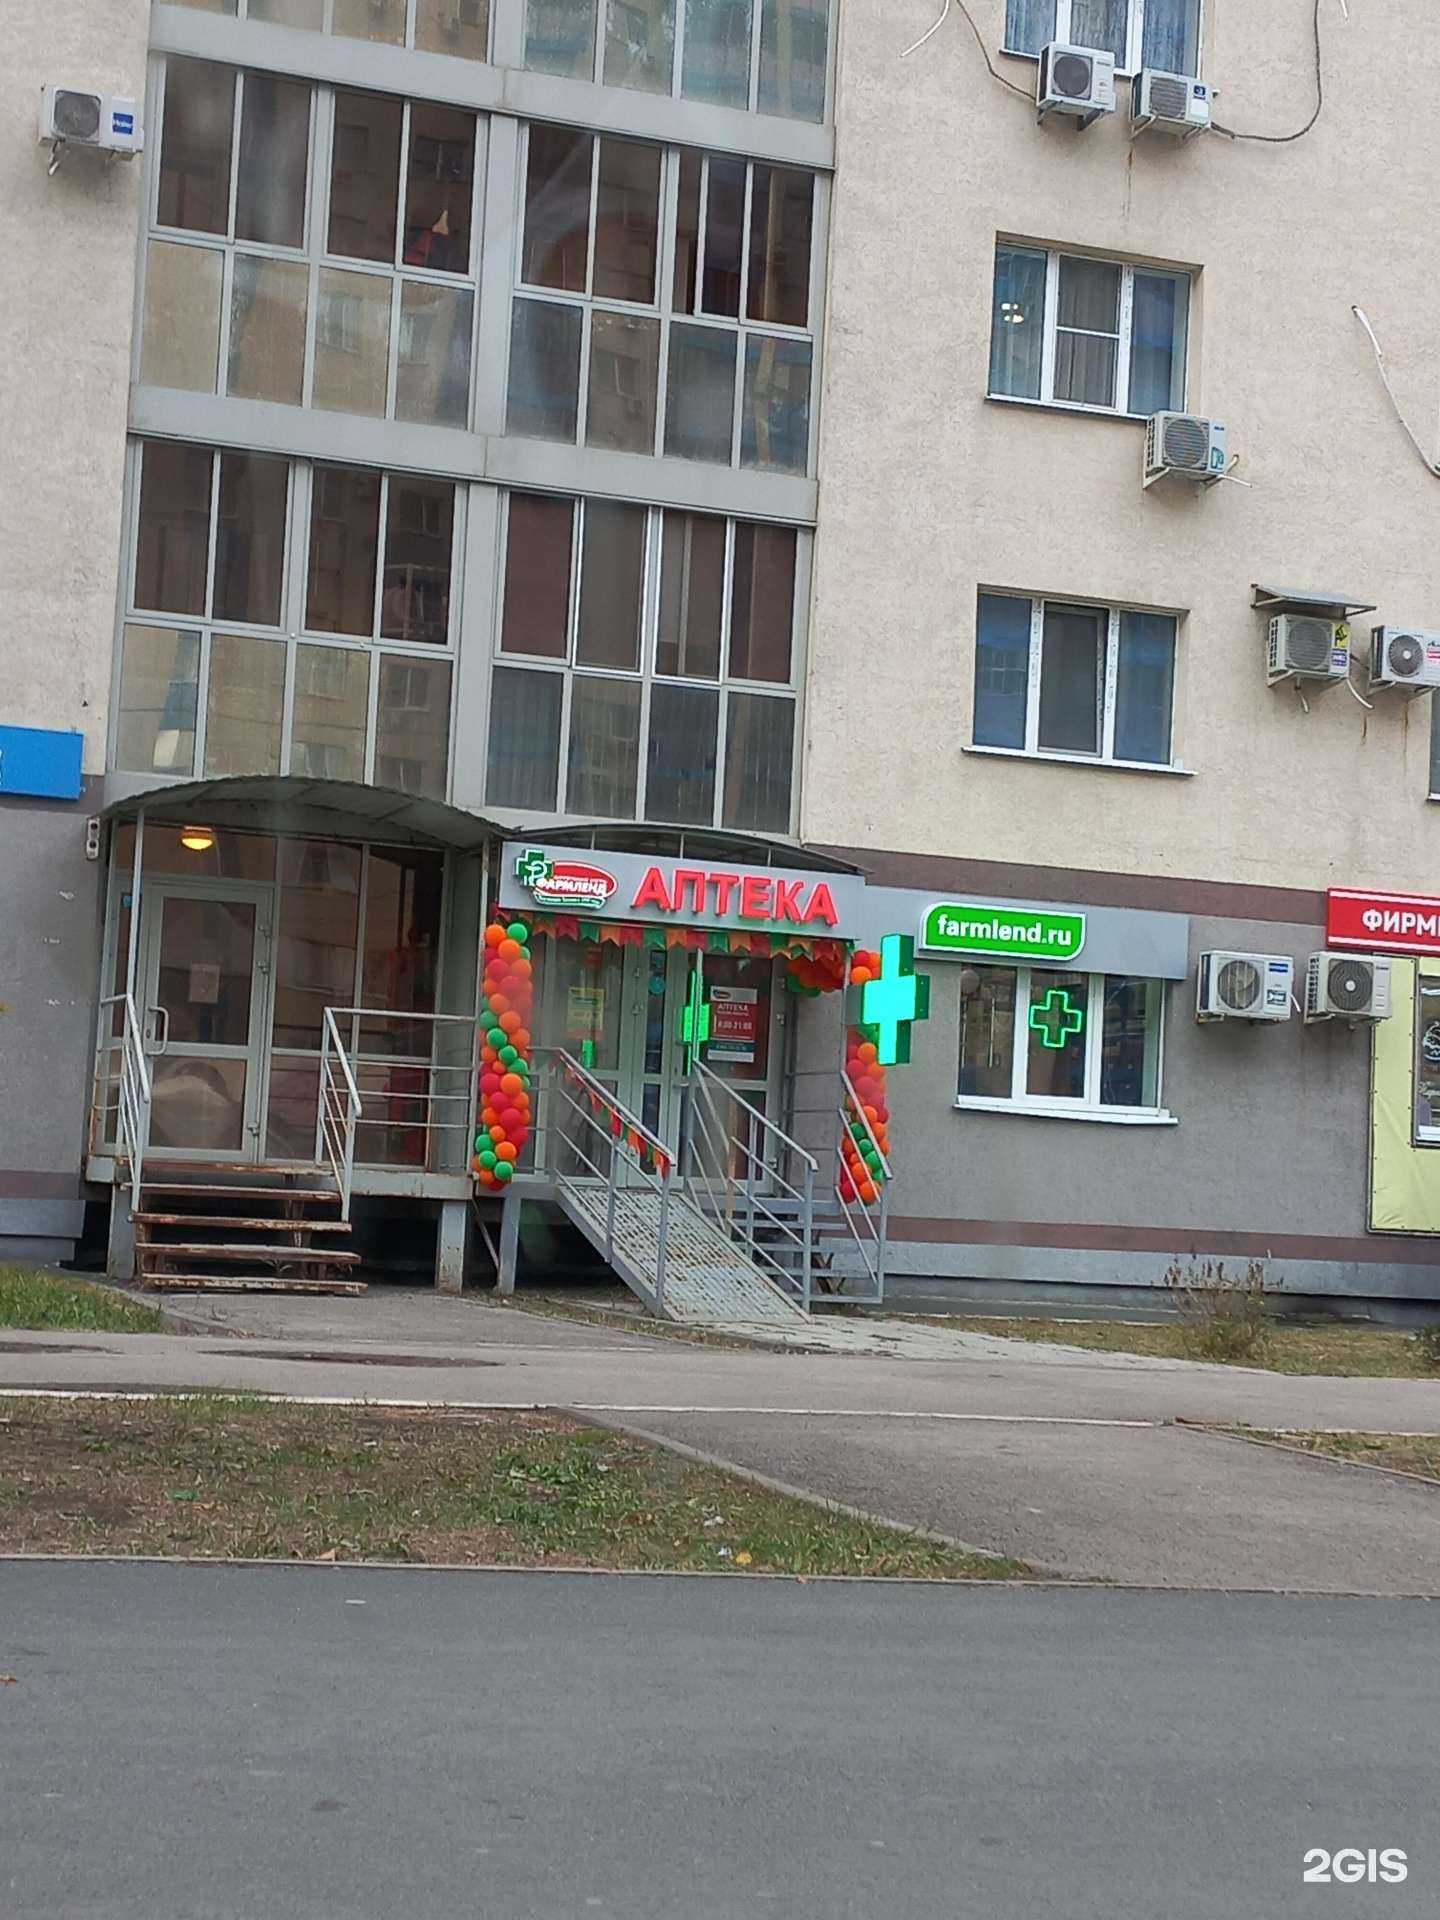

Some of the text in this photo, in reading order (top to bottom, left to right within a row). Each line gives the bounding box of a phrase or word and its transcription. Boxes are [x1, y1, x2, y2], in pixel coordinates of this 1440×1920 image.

[632, 867, 838, 925] АПТЕКА
[937, 914, 1072, 946] farmlend.ru
[1362, 908, 1440, 937] ФИРМ
